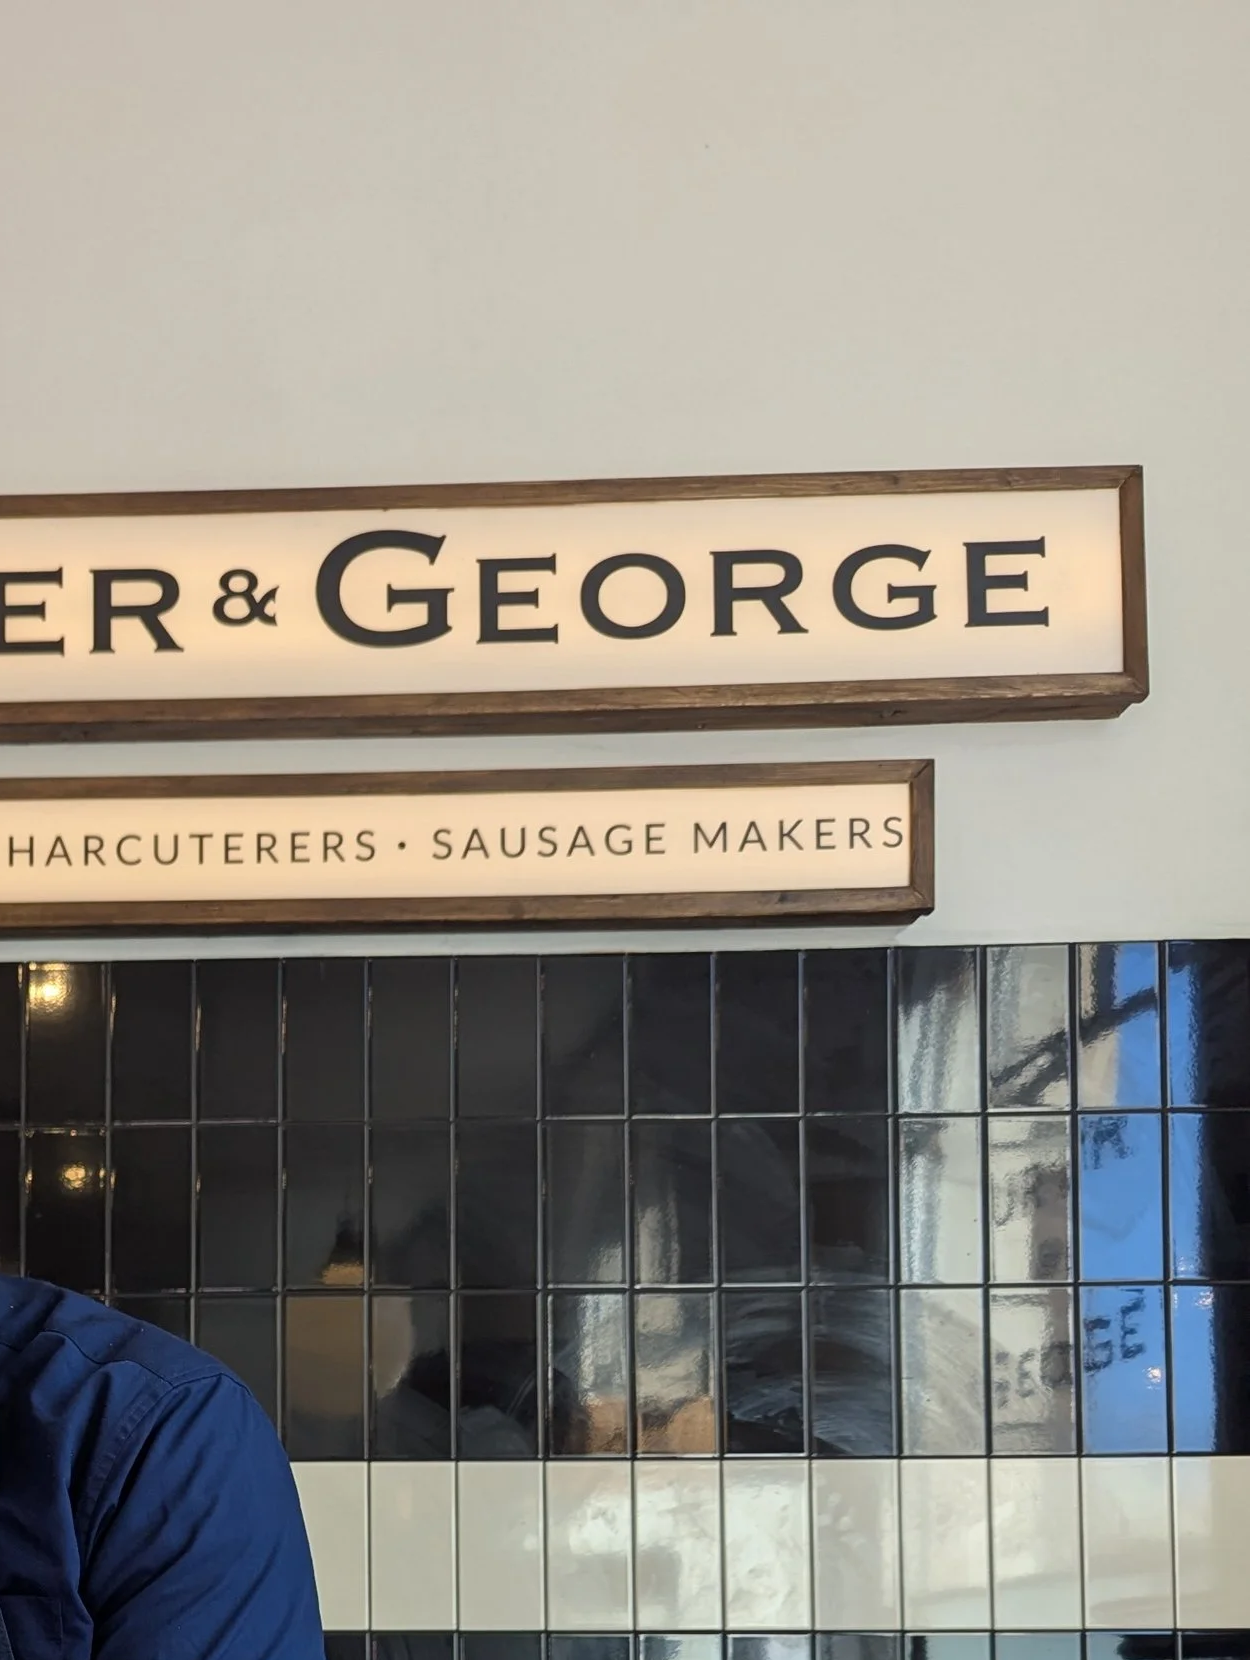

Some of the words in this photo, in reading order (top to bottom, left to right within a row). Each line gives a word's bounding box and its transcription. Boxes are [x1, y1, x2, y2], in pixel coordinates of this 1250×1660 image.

[211, 568, 279, 626] &
[315, 530, 1051, 648] GEORGE
[431, 822, 668, 861] SAUSAGE
[692, 816, 905, 855] MAKERS
